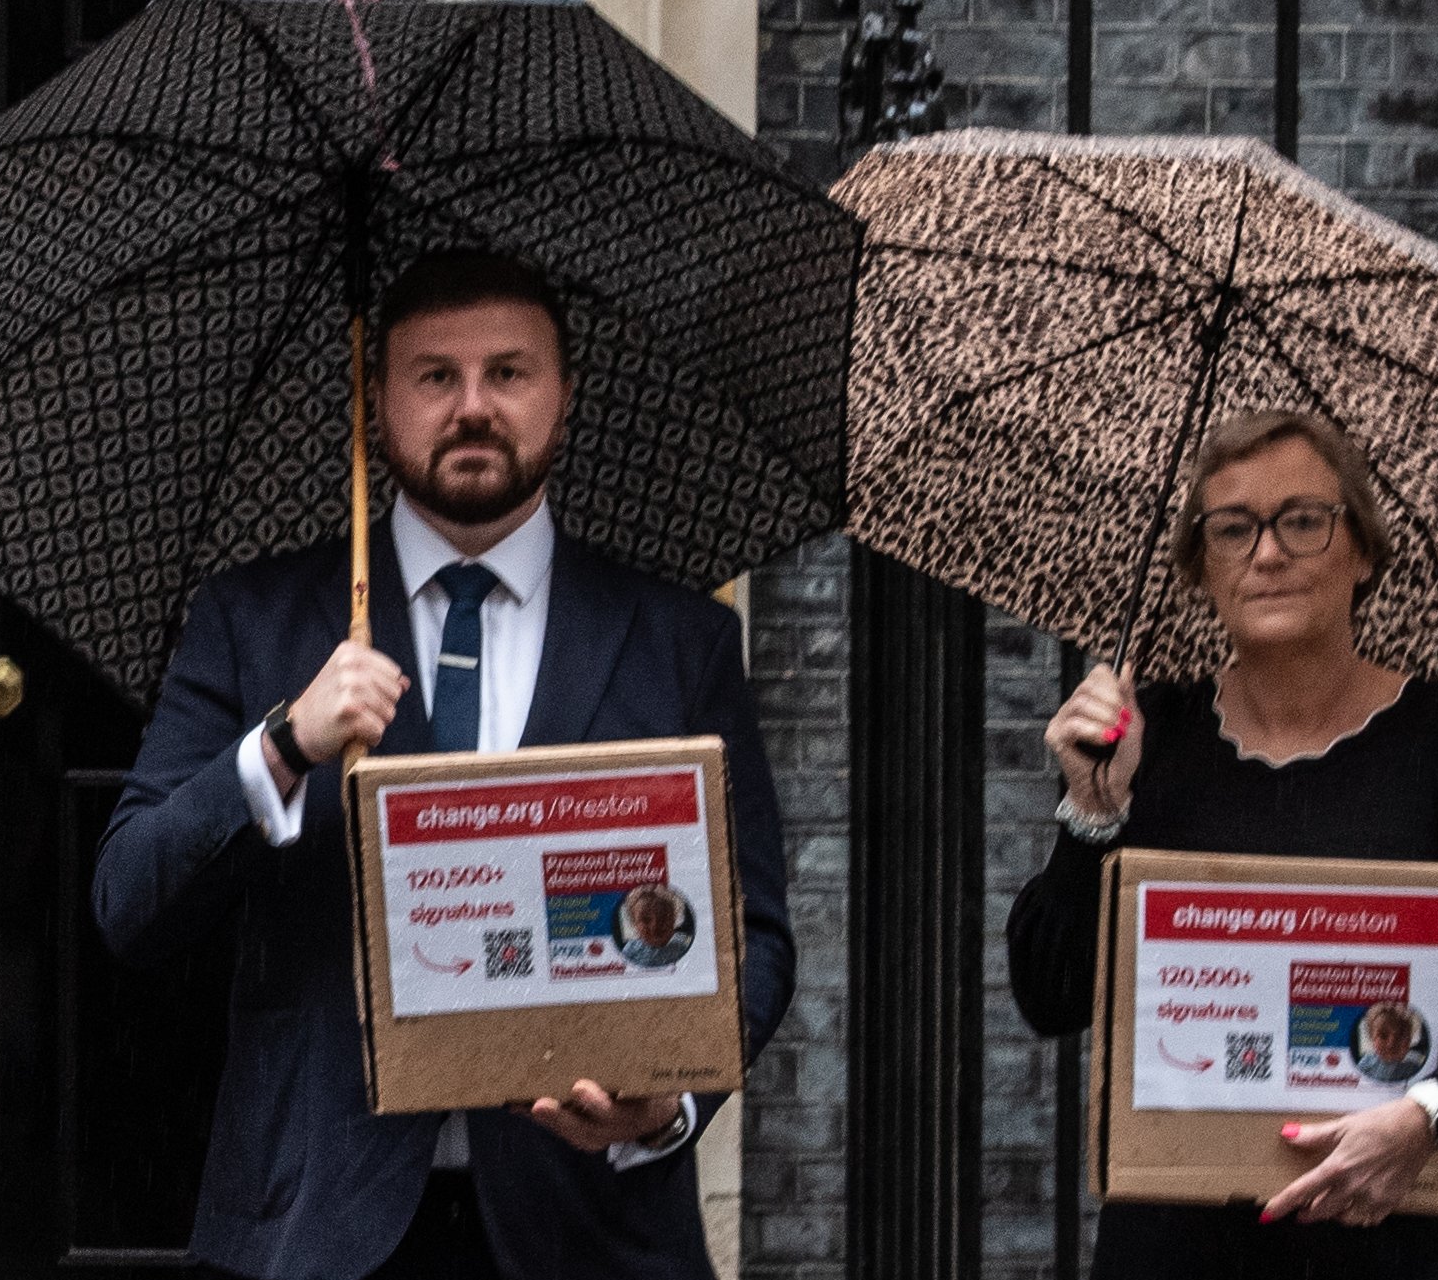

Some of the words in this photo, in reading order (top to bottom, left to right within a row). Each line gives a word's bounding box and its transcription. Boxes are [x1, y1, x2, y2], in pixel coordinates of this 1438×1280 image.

[405, 863, 506, 893] 120,500+
[408, 899, 515, 927] signatures
[1157, 965, 1253, 991] 120,500+
[1156, 998, 1259, 1024] signatures
